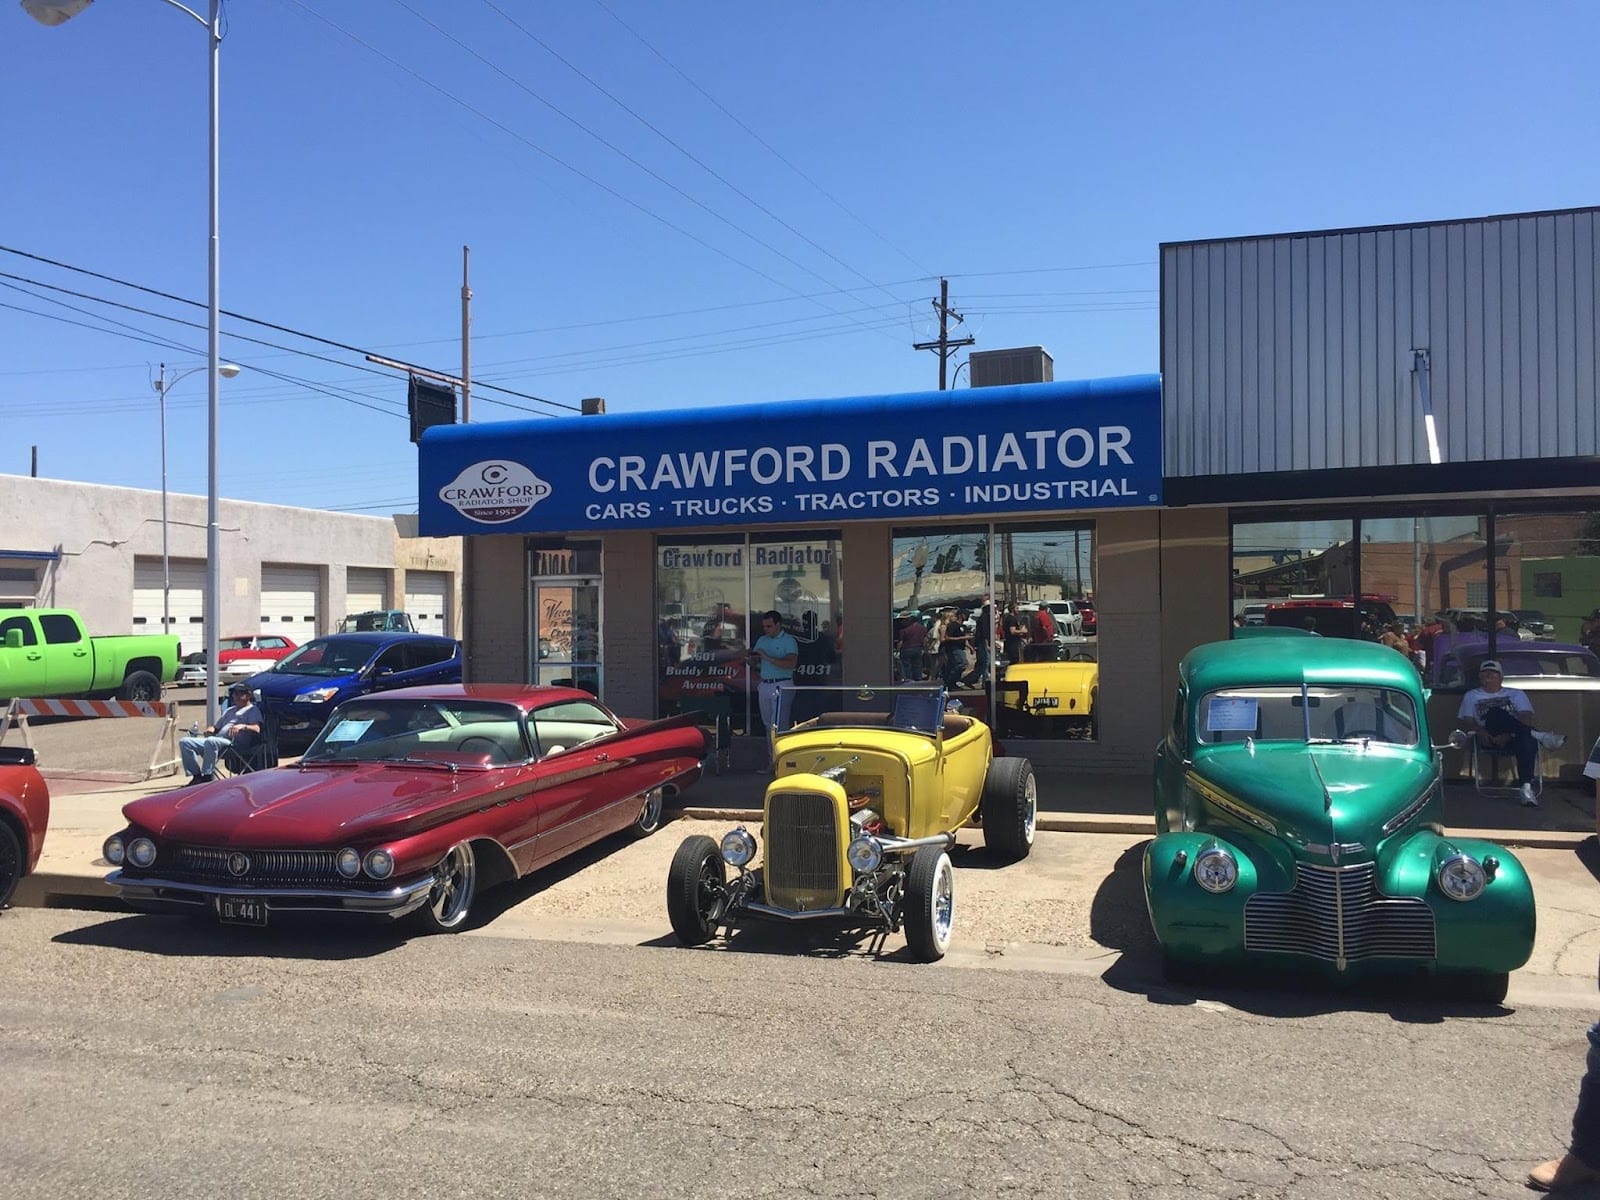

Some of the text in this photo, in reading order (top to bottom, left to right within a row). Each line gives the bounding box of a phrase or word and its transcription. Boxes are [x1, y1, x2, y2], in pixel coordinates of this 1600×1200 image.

[588, 425, 1135, 493] CRAWFORD RADIATOR
[444, 484, 548, 500] CRAWFORD
[585, 478, 1138, 520] CARS TRUCKS TRACTORS INDUSTRIAL
[459, 496, 533, 507] RADIATOR SHOP
[495, 508, 517, 516] 1952
[662, 546, 832, 568] Crawford Radiator
[665, 665, 740, 677] Buddy Holly
[682, 680, 725, 689] Avenue
